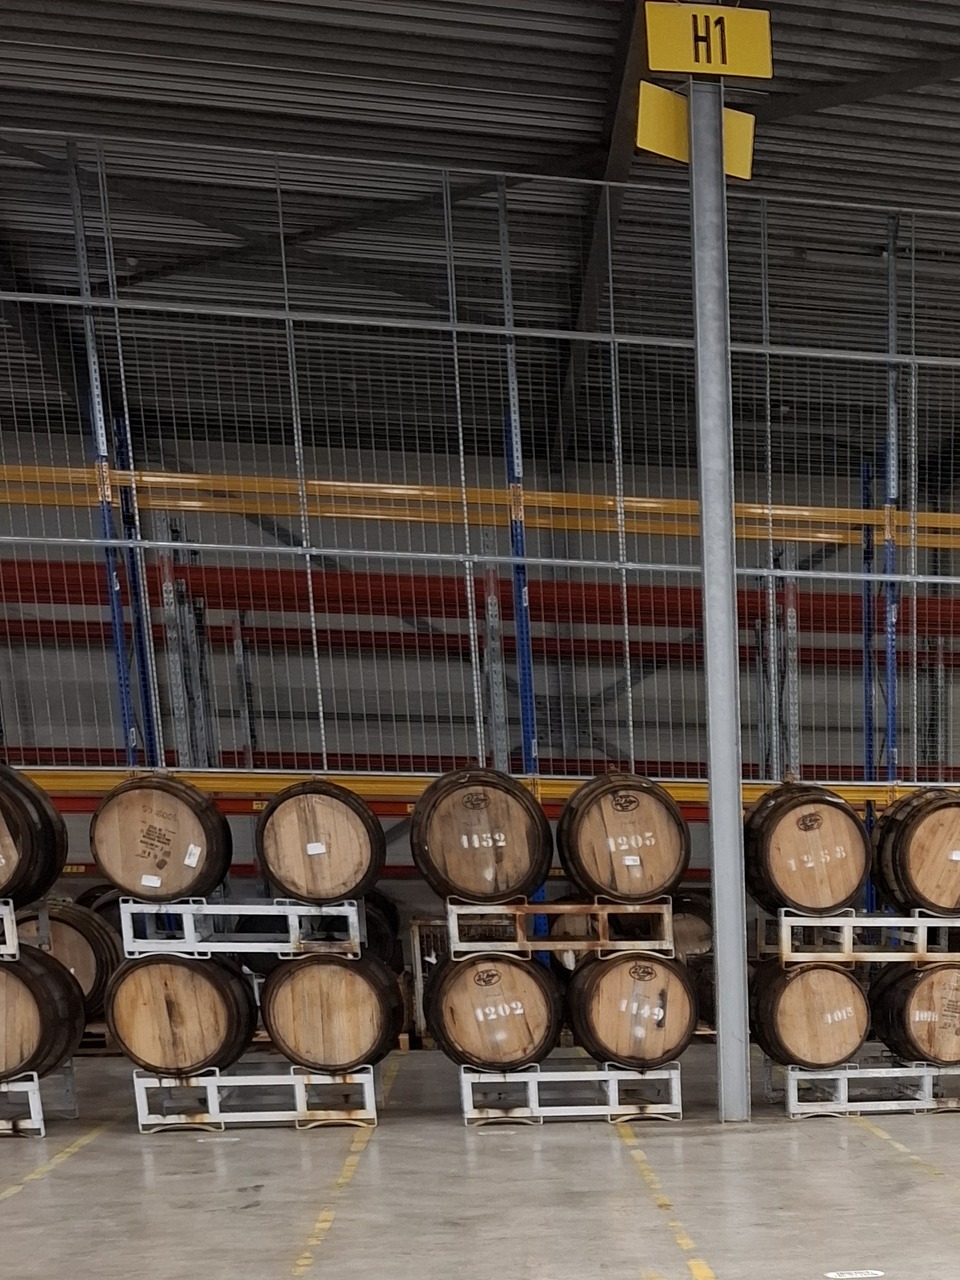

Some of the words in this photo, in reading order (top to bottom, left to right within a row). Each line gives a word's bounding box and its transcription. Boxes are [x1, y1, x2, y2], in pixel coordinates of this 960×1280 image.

[692, 14, 727, 65] H1
[461, 832, 506, 849] 1152
[609, 832, 655, 852] 1205
[475, 1000, 524, 1022] 1202
